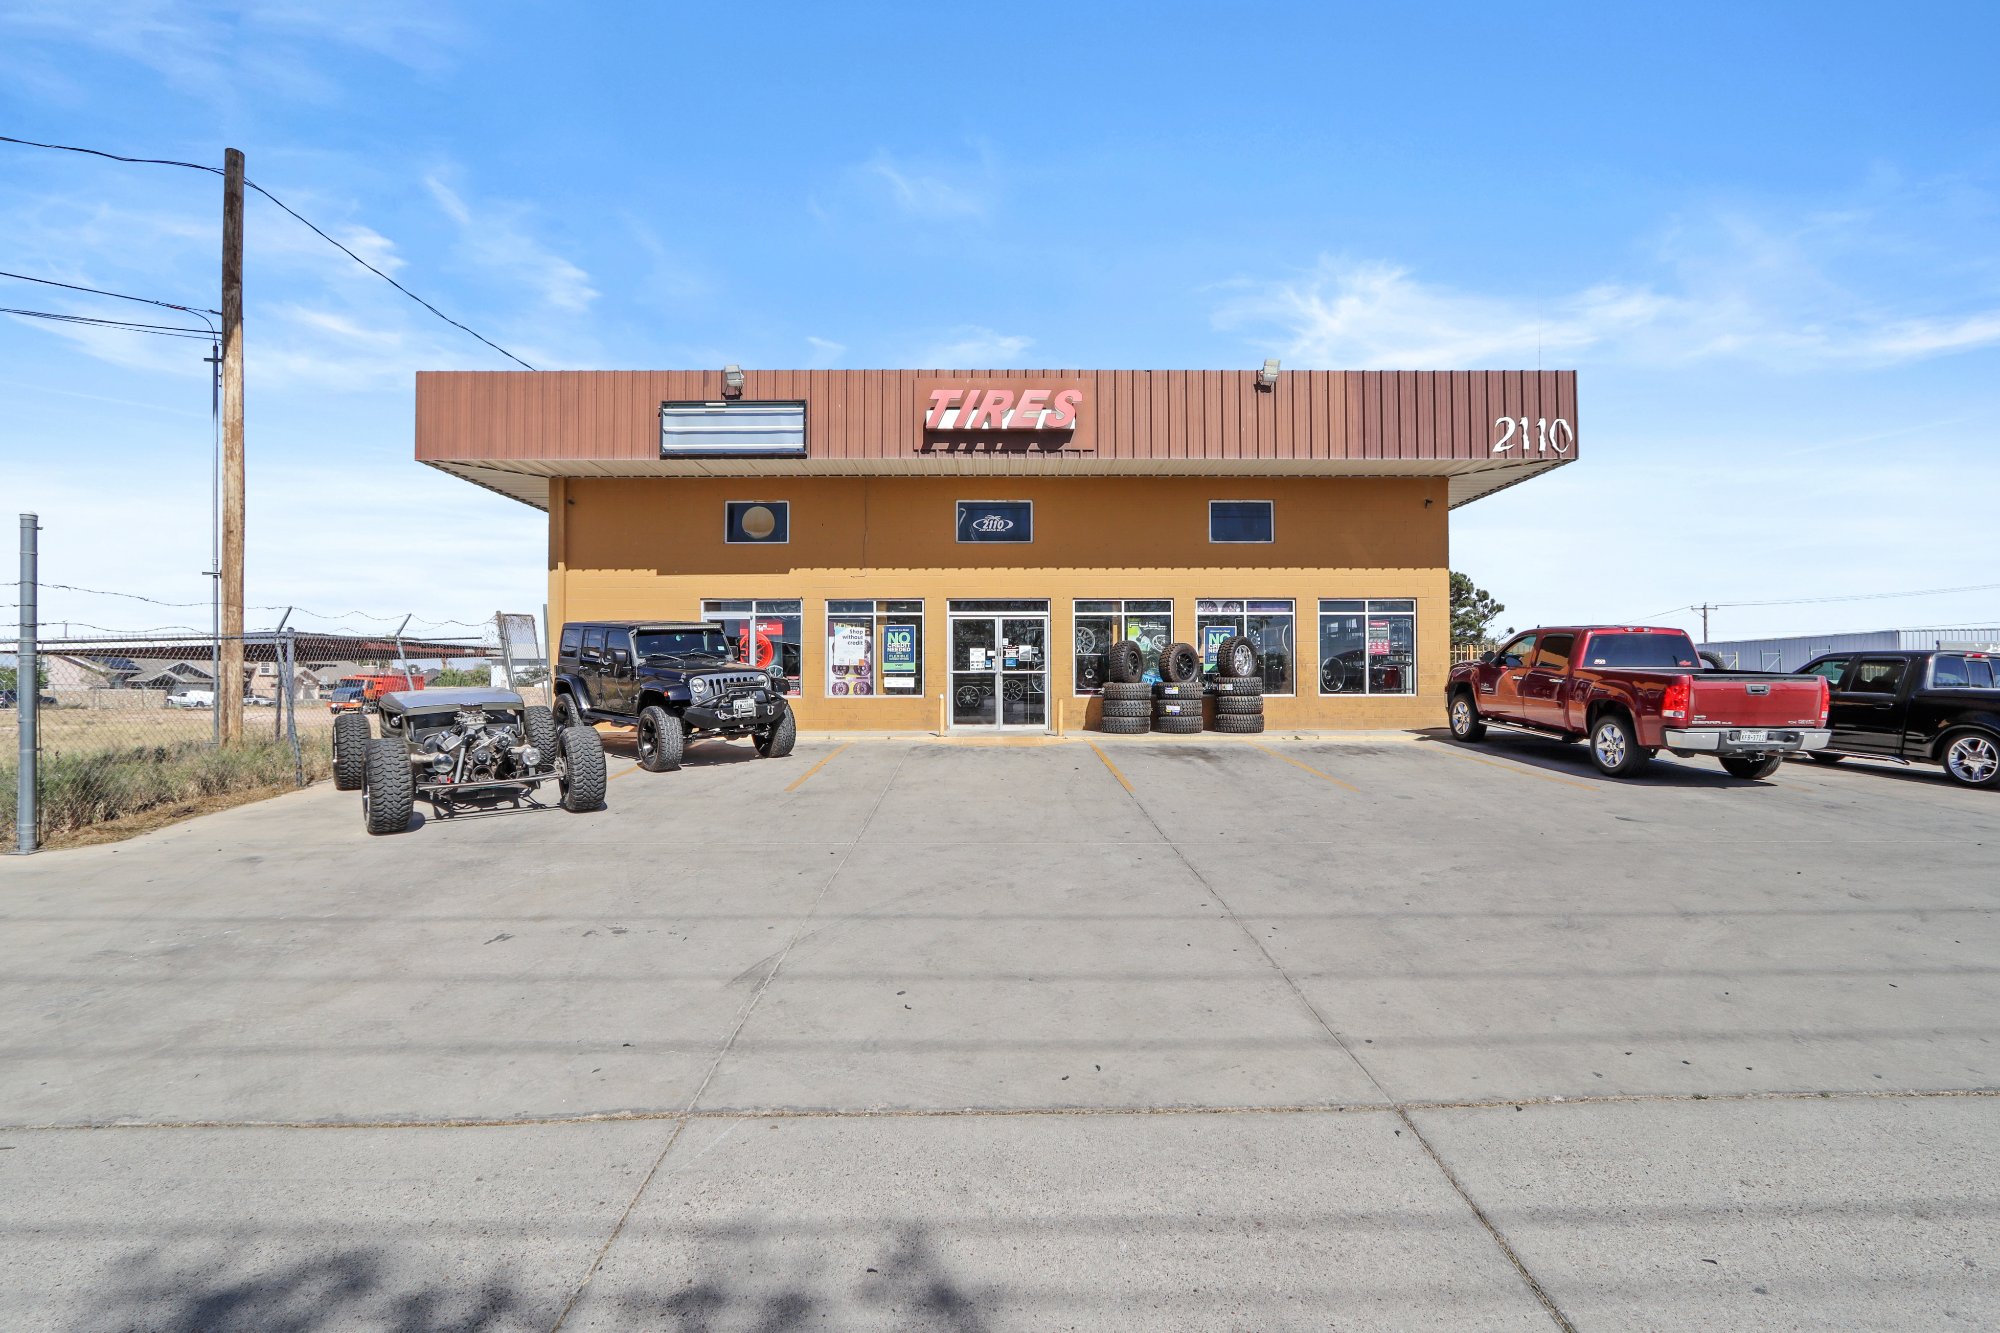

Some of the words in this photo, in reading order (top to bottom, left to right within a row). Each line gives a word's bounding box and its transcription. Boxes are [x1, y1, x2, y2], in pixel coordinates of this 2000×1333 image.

[925, 389, 1083, 429] TIRES
[1492, 416, 1573, 453] 2110
[982, 519, 1005, 530] 2110
[887, 631, 911, 644] NO
